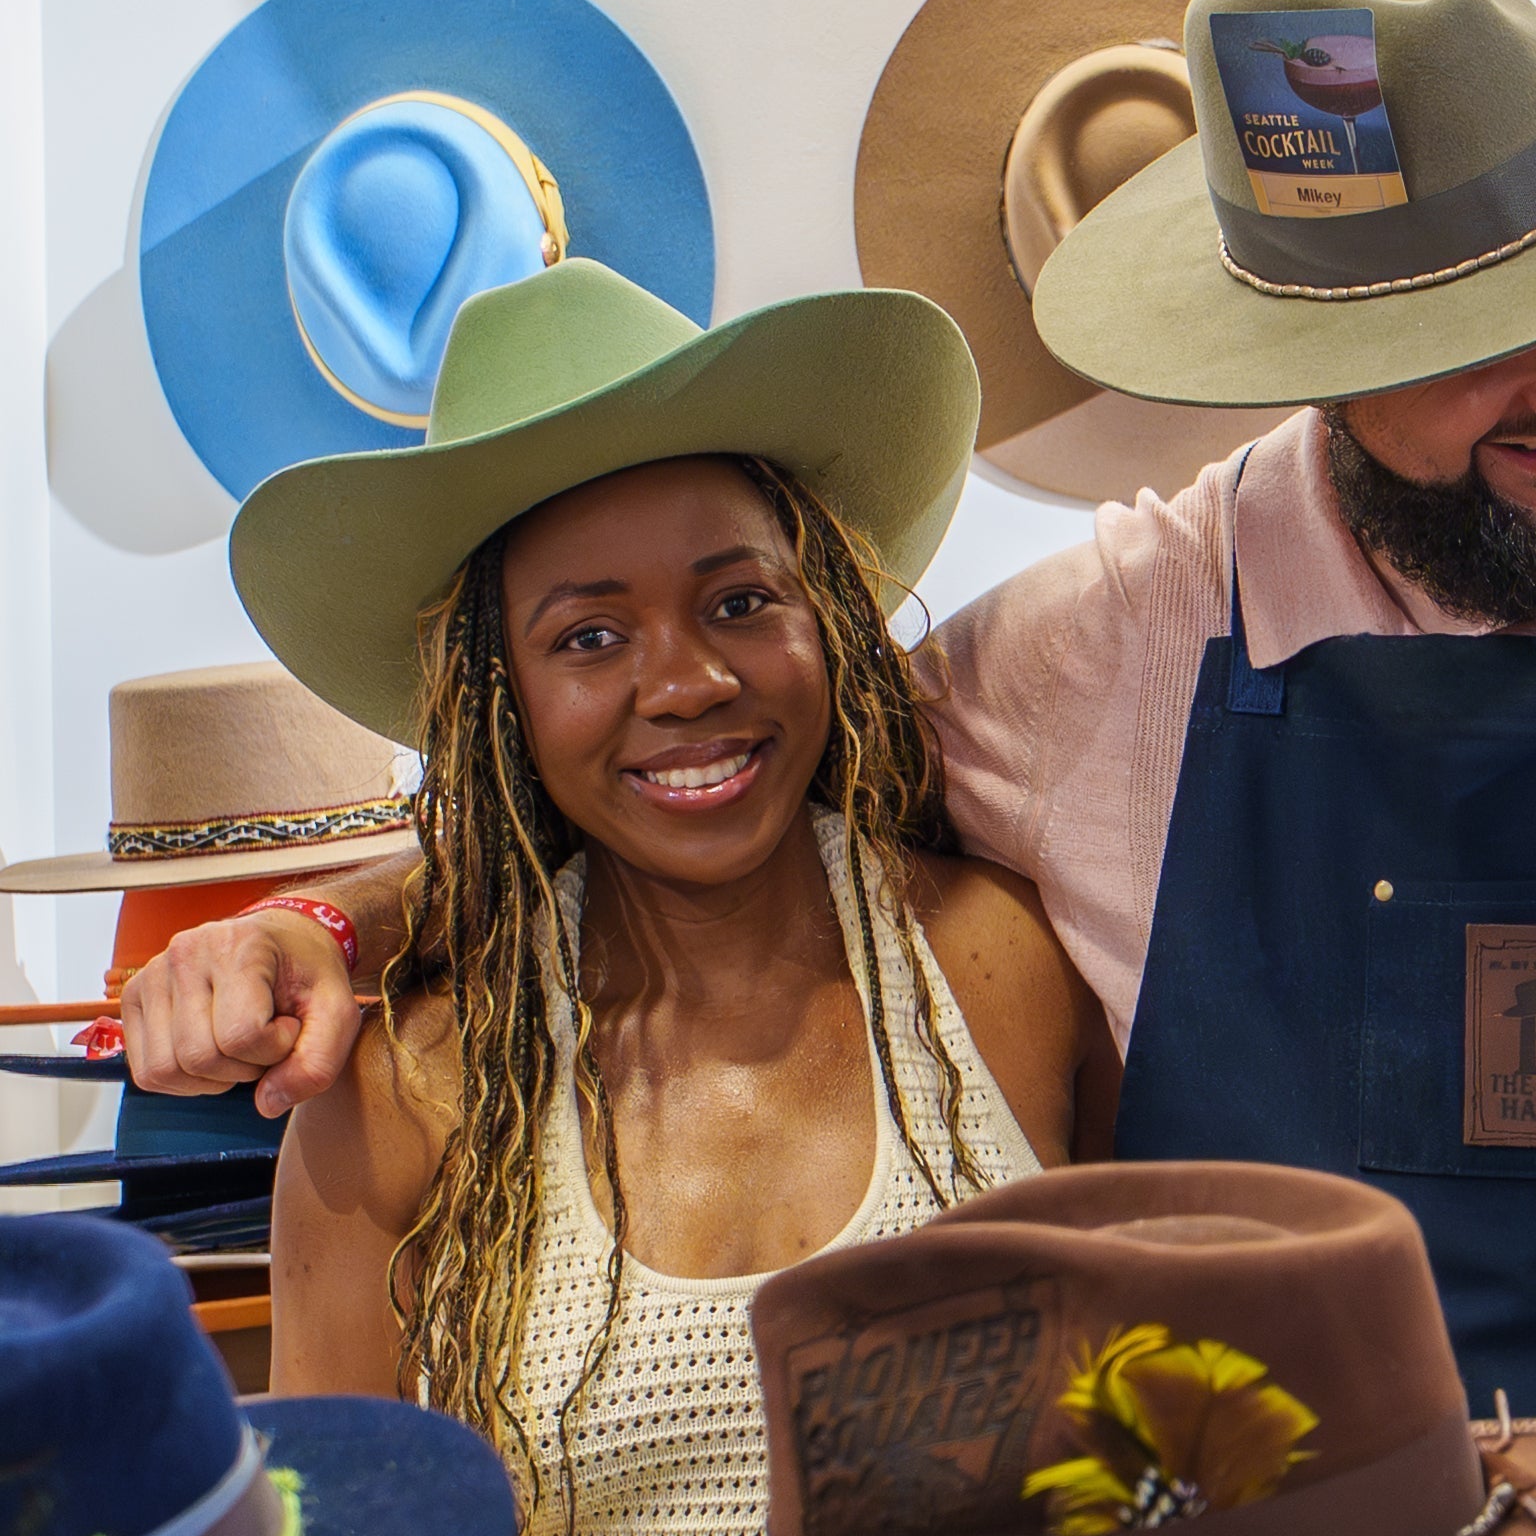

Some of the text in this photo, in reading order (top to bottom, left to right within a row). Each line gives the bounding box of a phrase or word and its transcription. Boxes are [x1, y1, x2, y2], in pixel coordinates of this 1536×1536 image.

[1244, 114, 1299, 126] SEATTLE
[1244, 129, 1341, 158] COCKTAIL
[1302, 159, 1335, 169] WEEK
[1297, 187, 1342, 207] Mikey
[1489, 1074, 1532, 1095] THE
